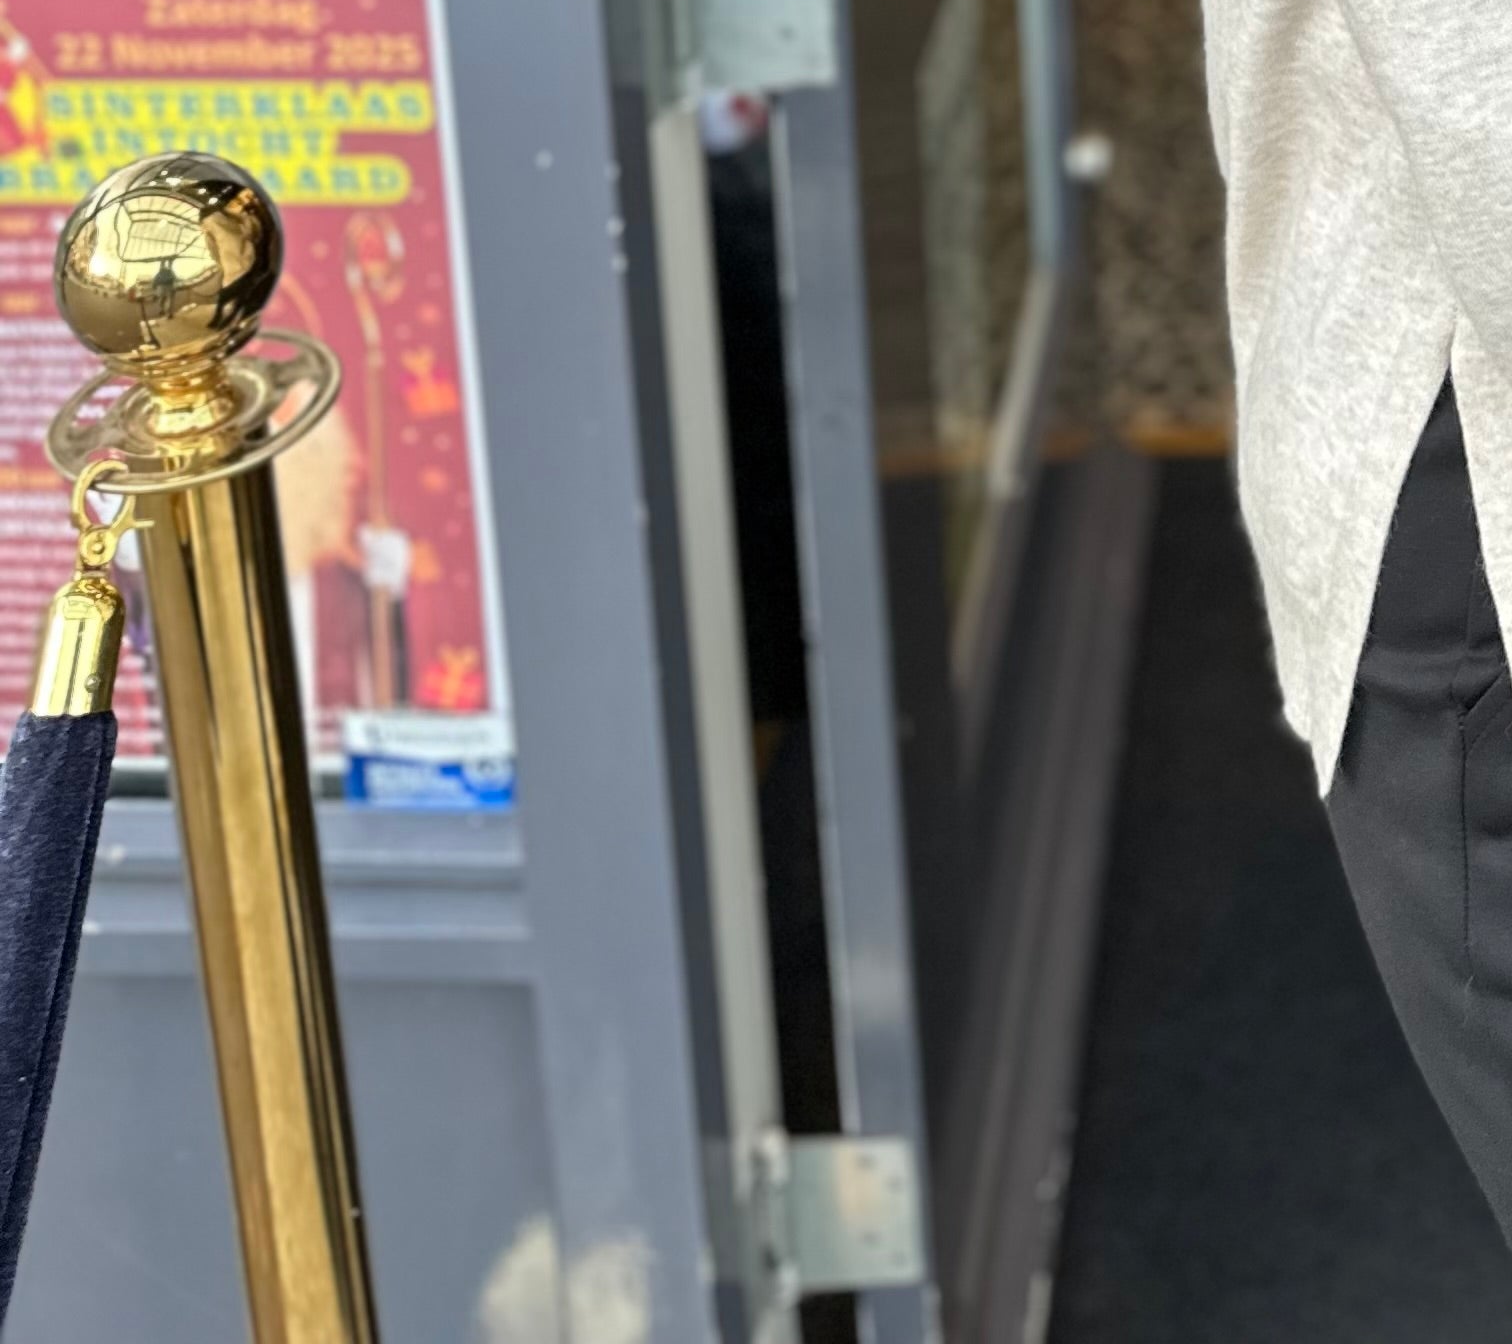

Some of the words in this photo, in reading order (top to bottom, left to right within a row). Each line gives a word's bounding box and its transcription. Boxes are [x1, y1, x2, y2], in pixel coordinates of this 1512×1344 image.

[55, 34, 101, 70] 22
[111, 32, 316, 70] November
[326, 32, 421, 70] 2025
[48, 90, 424, 119] SINTERKLAAS
[95, 130, 325, 157] INTOCHT
